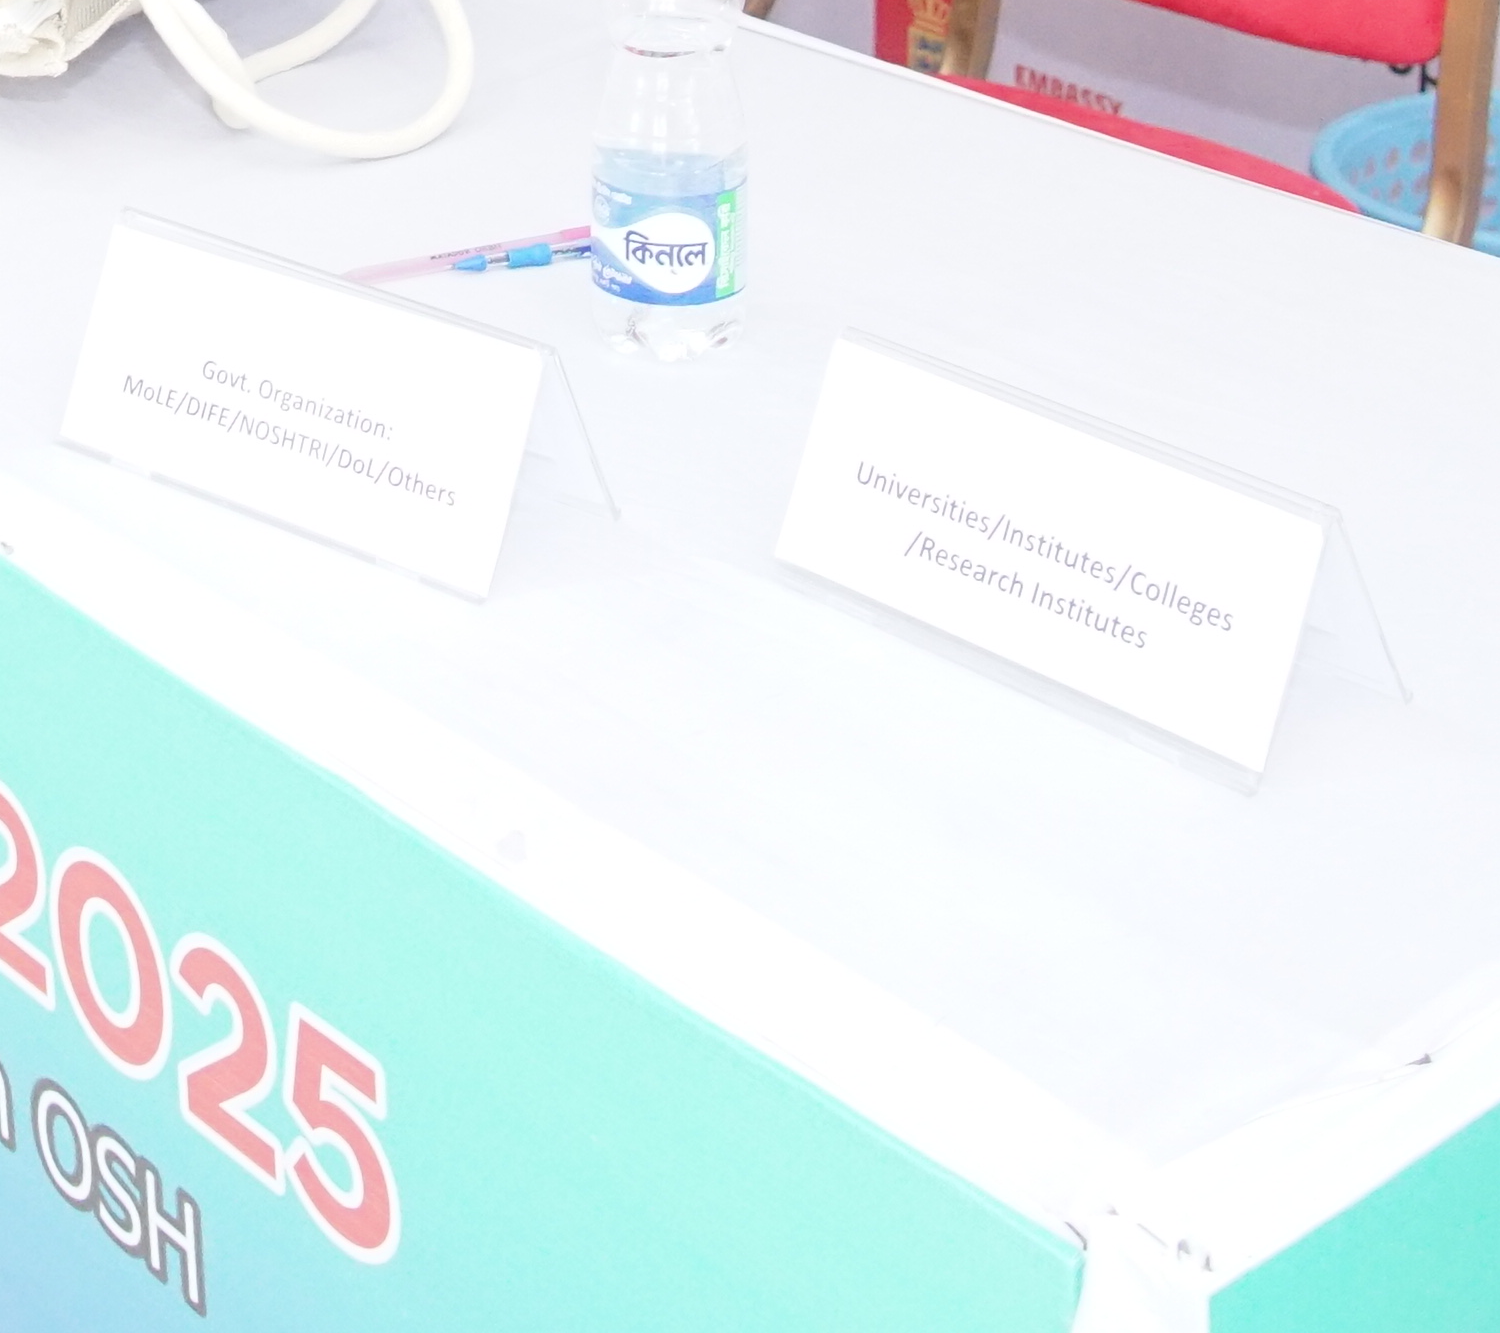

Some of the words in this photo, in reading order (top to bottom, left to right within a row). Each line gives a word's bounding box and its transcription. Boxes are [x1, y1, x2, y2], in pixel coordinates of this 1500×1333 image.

[1014, 63, 1123, 116] EMBASSY
[122, 374, 456, 507] MoLE/DIFE/NOSHTRI/DoL/Others
[202, 360, 252, 394] Govt.
[258, 379, 394, 441] Organization:
[856, 461, 1234, 633] Universities/Institutes/Colleges
[904, 530, 1024, 599] /Research
[1030, 581, 1148, 650] Institutes
[32, 1074, 209, 1318] OSH
